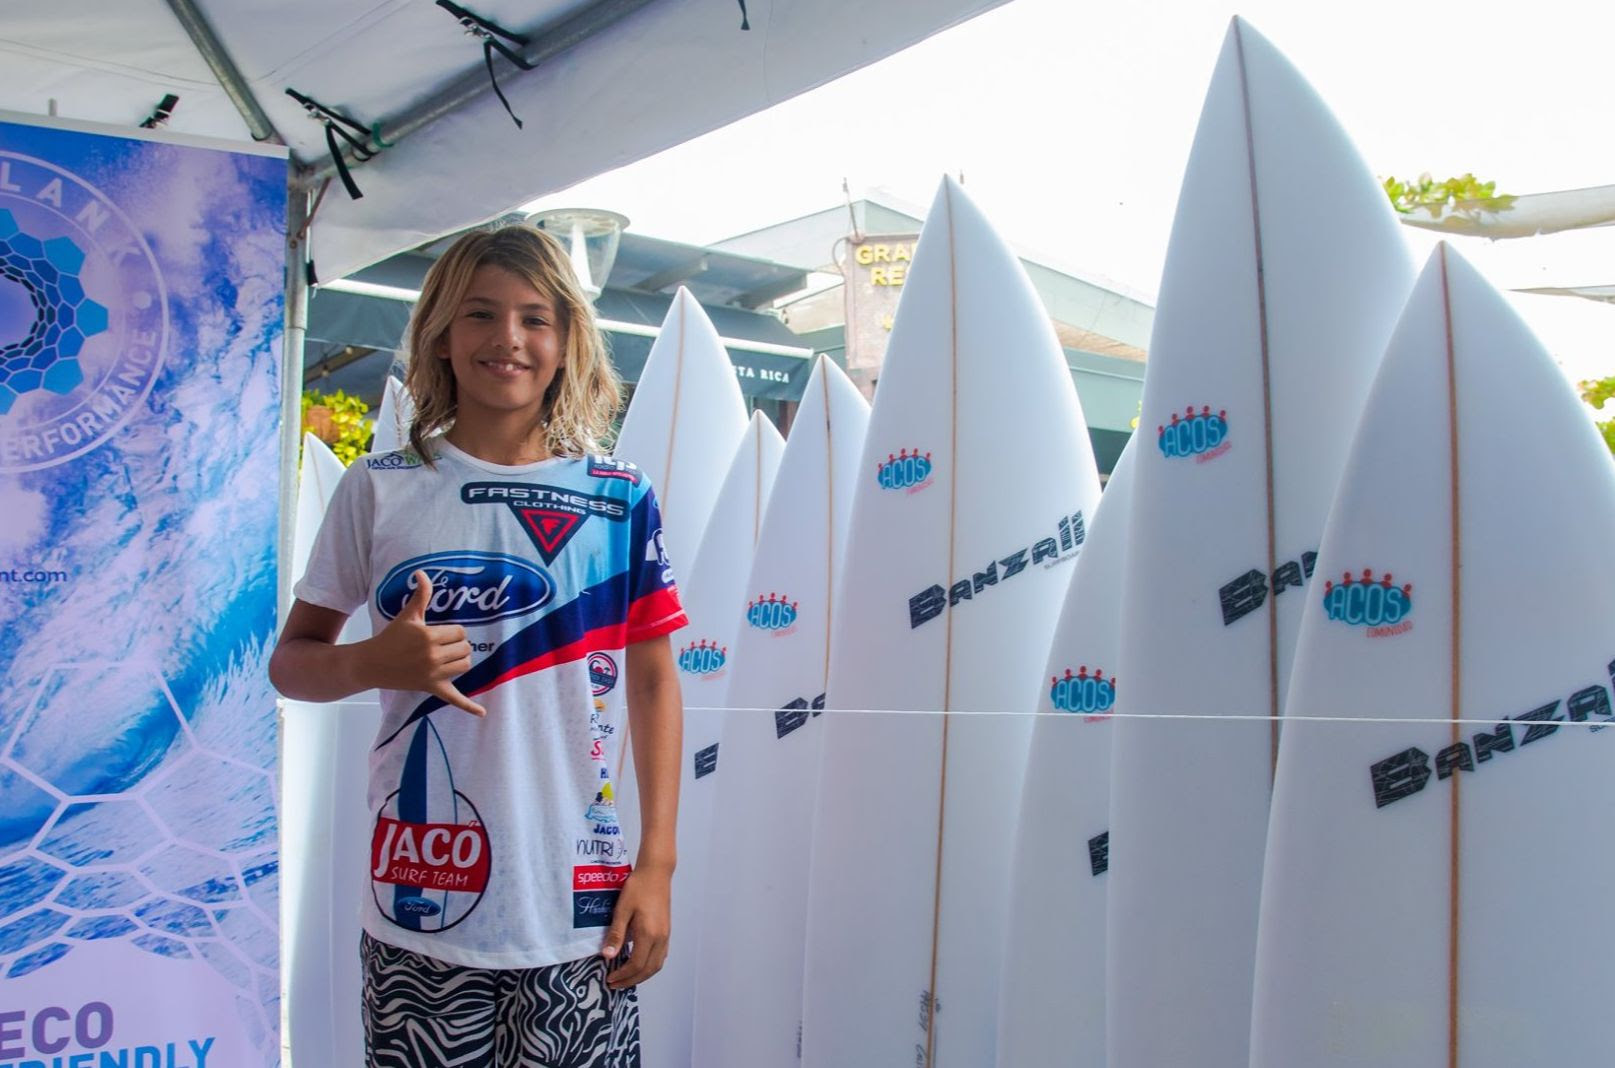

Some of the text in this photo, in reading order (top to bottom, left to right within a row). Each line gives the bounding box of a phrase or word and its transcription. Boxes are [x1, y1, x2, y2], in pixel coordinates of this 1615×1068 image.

[856, 243, 918, 265] GRA
[734, 365, 790, 384] TA RICA
[1163, 415, 1222, 458] ACOS
[881, 456, 927, 489] ACOS
[468, 487, 624, 516] FASTNESS
[513, 500, 587, 515] CLOTHING
[402, 565, 514, 613] Ford
[750, 602, 793, 629] ACOS
[1330, 583, 1402, 625] ACOS
[682, 647, 722, 674] ACOS
[1056, 677, 1111, 713] ACOS
[391, 866, 469, 887] SURF TEAM
[577, 871, 619, 885] speedo
[0, 1001, 114, 1060] ECO
